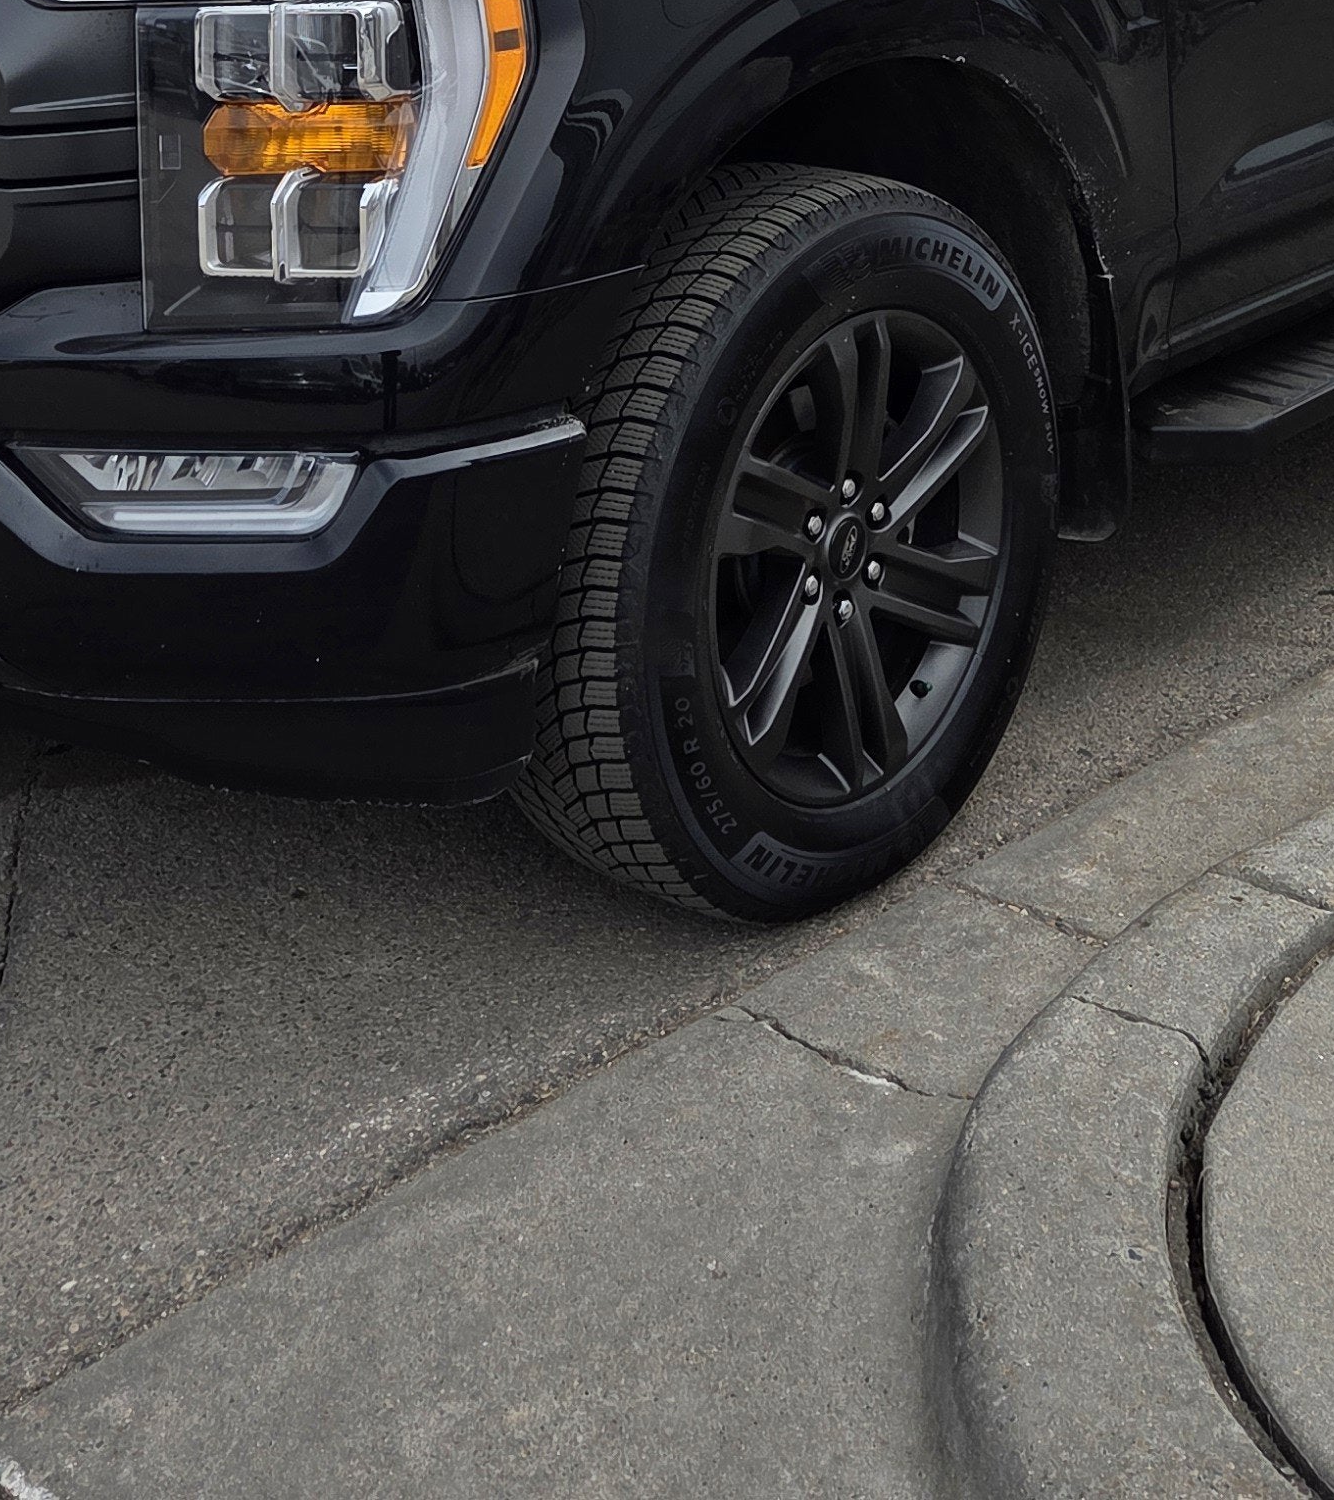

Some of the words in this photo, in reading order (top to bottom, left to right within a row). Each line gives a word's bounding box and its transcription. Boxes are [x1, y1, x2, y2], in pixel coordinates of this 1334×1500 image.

[879, 236, 1001, 300] MICHELIN
[674, 697, 695, 729] 20
[683, 737, 701, 755] R
[689, 760, 738, 835] 275/60
